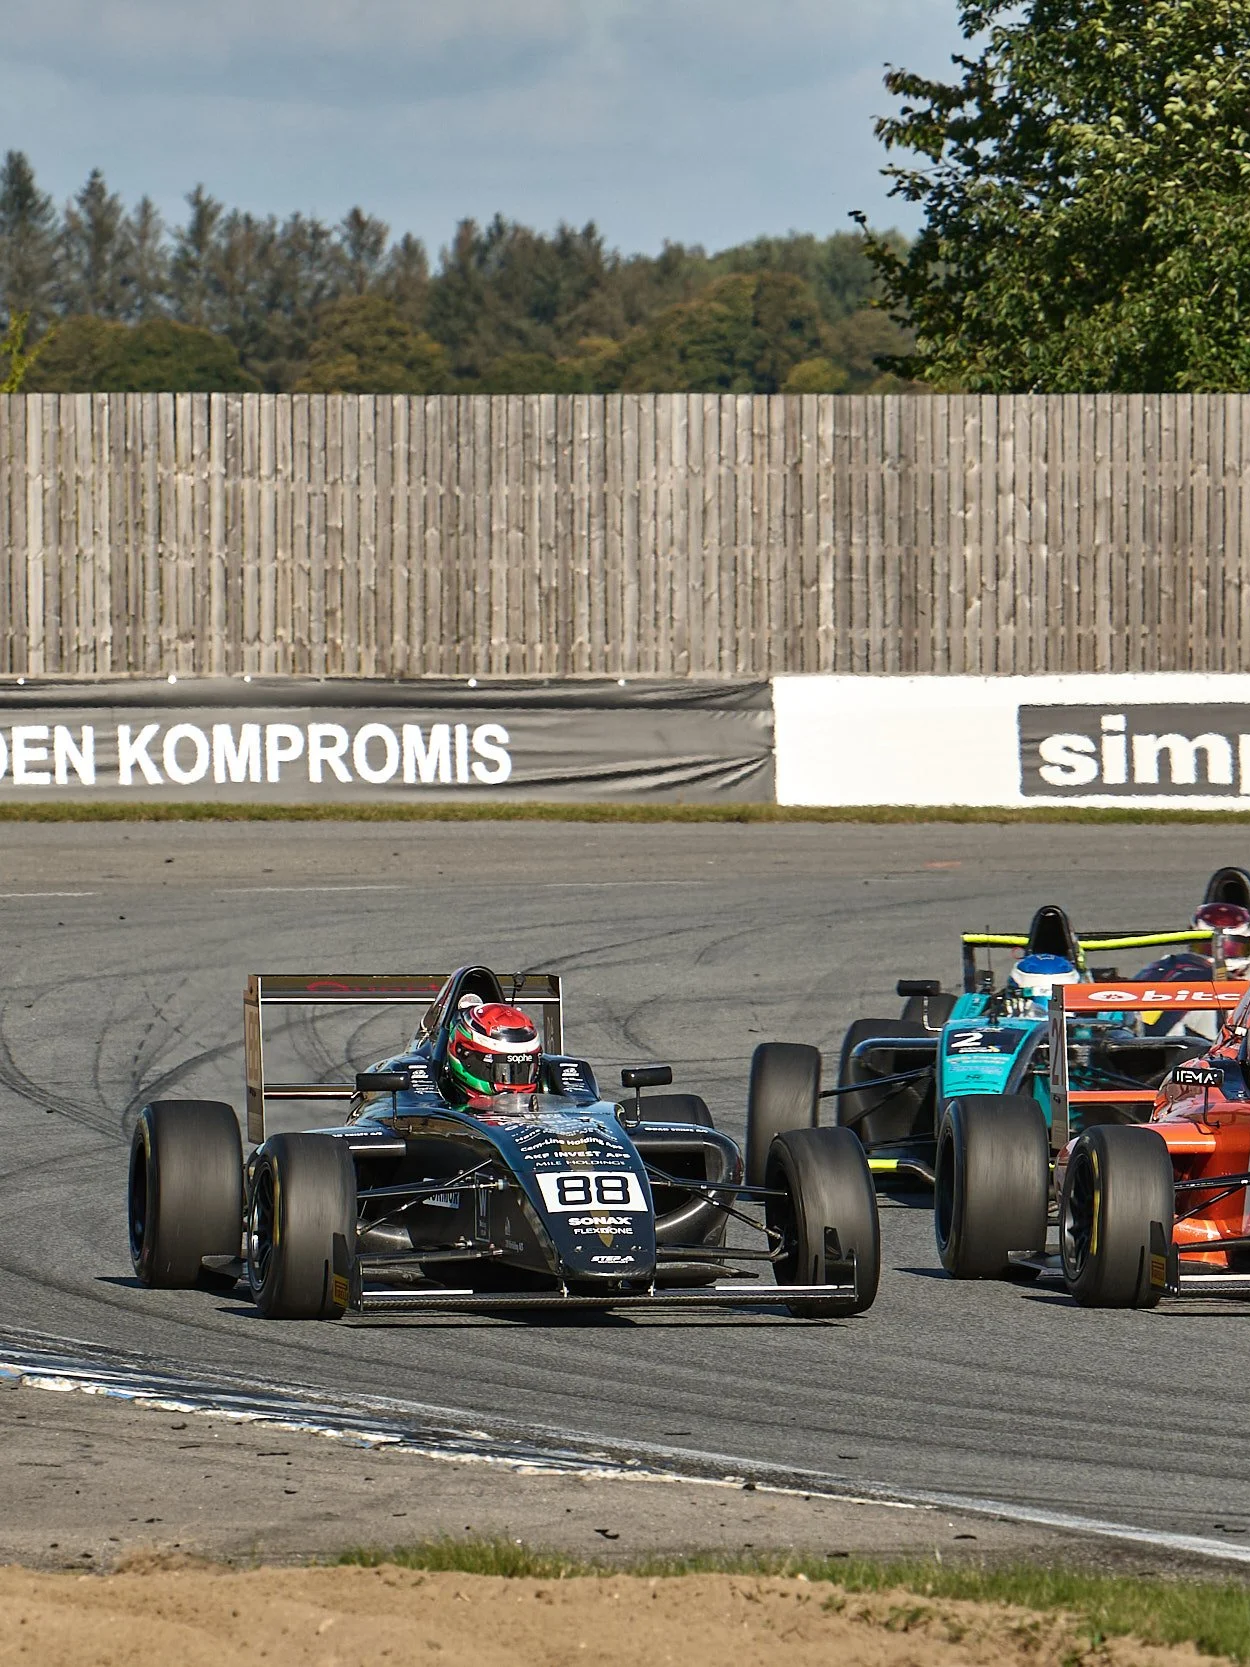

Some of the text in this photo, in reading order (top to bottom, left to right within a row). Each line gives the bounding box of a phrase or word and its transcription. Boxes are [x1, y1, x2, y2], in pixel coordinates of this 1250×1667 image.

[0, 722, 512, 785] EN KOMPROMIS
[950, 1032, 984, 1048] 2
[554, 1150, 601, 1158] INVEST
[556, 1175, 631, 1205] 88
[568, 1216, 632, 1226] SONAX
